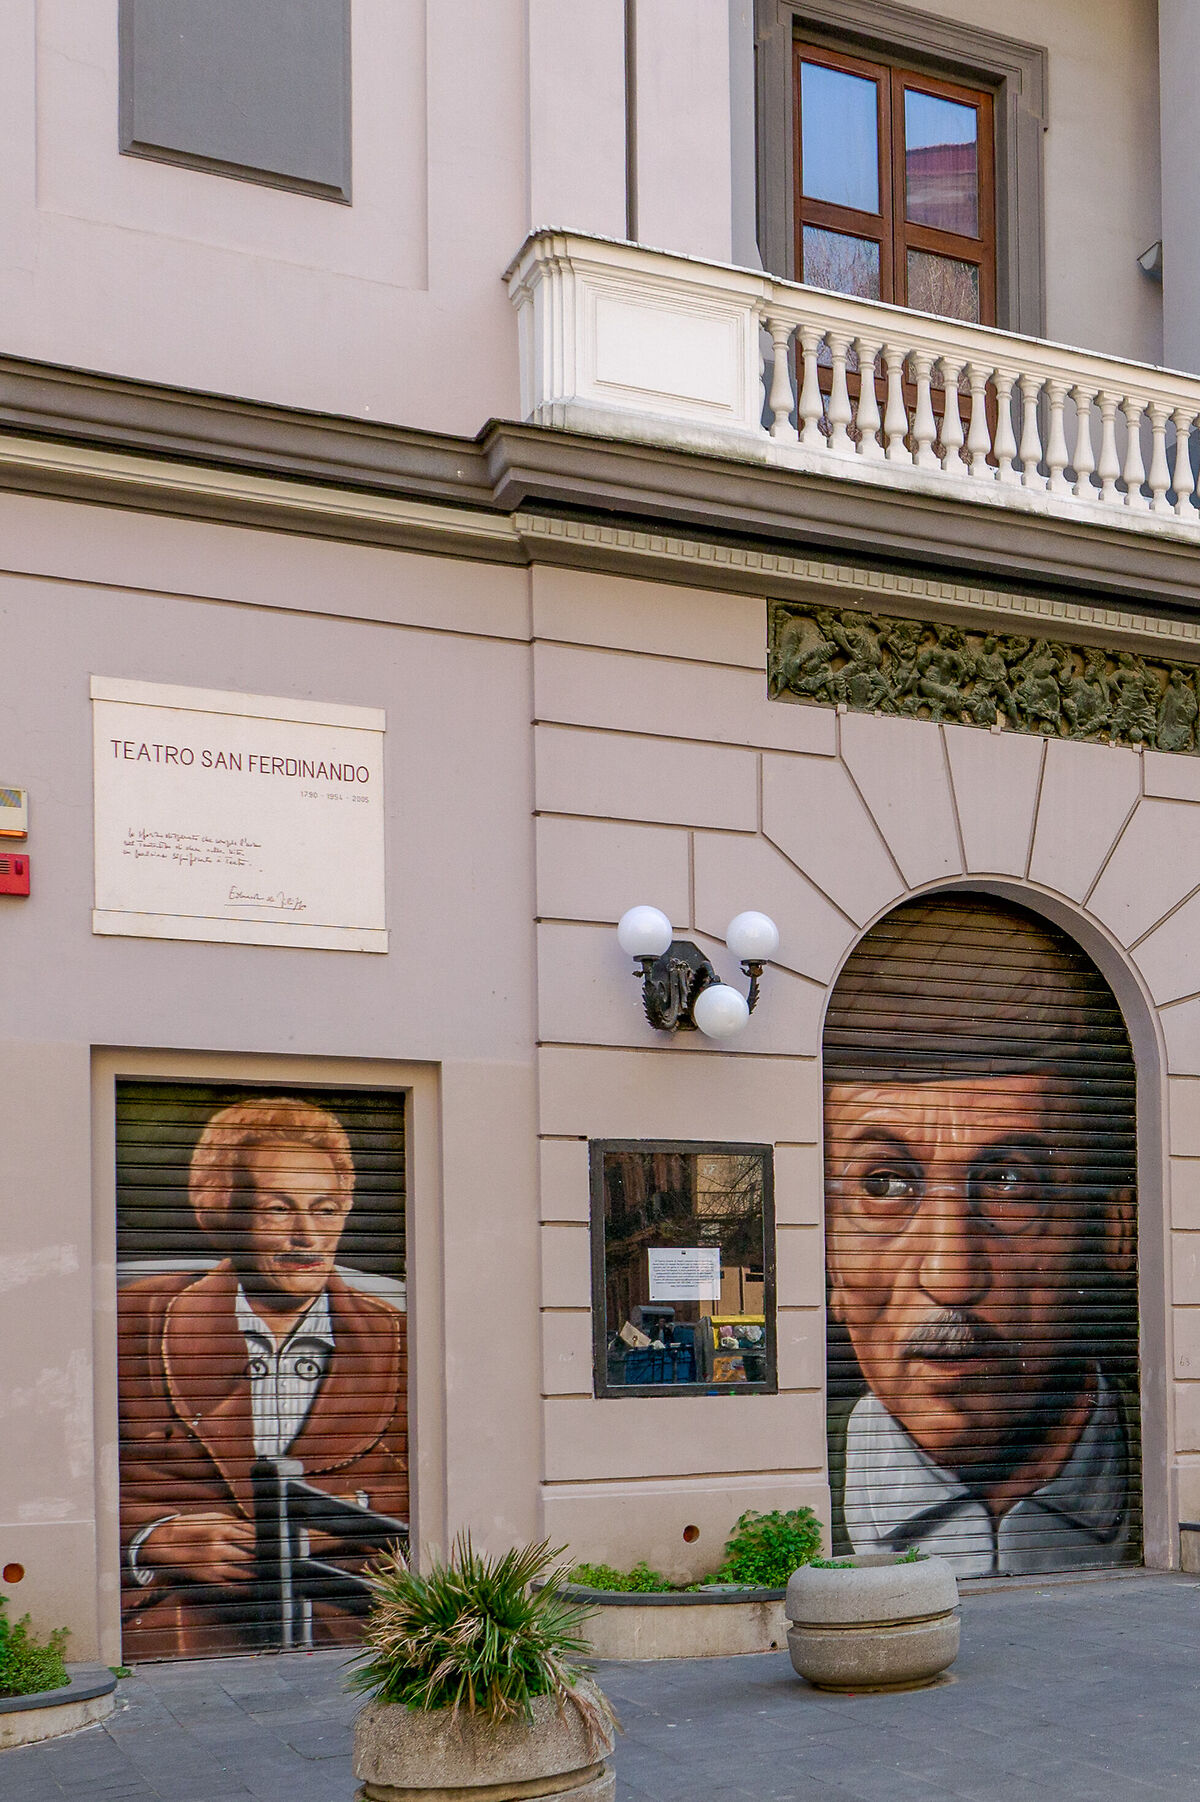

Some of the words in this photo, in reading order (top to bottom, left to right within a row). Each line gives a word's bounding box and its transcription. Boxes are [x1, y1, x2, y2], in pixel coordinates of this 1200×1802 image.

[110, 739, 195, 766] TEATRO
[201, 749, 242, 772] SAN
[248, 754, 370, 784] FERDINANDO
